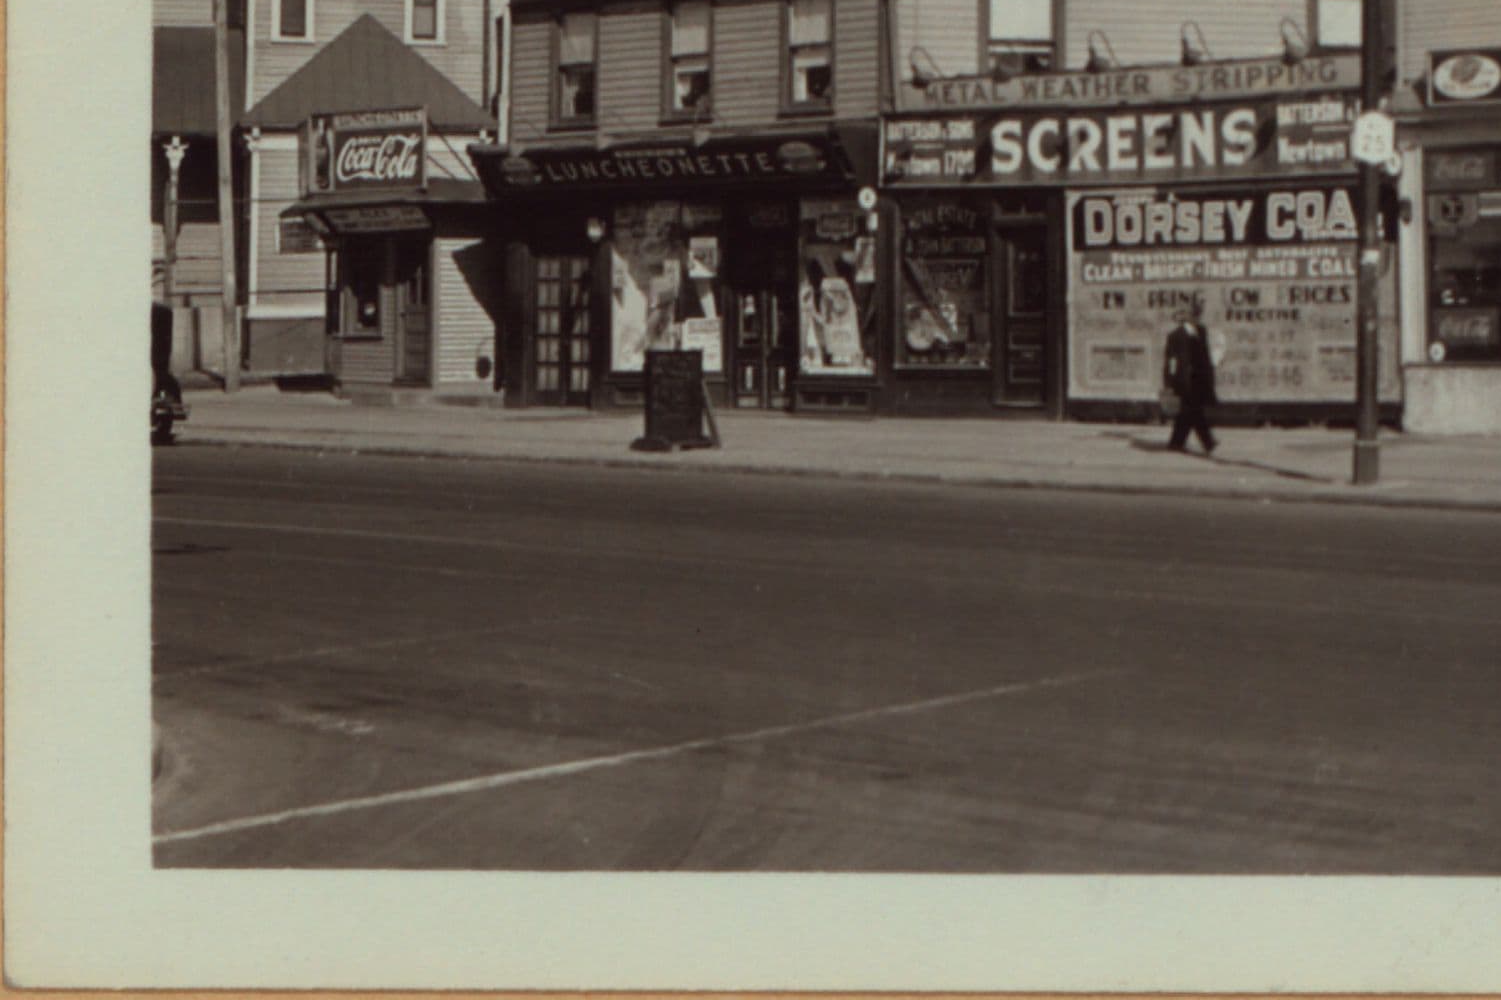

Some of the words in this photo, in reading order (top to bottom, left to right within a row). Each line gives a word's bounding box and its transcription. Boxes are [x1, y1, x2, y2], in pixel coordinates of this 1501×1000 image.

[924, 78, 1006, 105] METAL
[1022, 72, 1150, 100] WEATHER
[1172, 60, 1338, 93] STRIPPING
[336, 133, 422, 181] Coca-Cola
[991, 108, 1257, 173] SCREENS
[546, 152, 775, 181] LUNCHEONETTE
[1084, 199, 1253, 245] DORSEY
[1266, 189, 1384, 240] COA
[1084, 263, 1133, 281] CLEAN
[1250, 260, 1297, 276] MINED
[1307, 258, 1355, 276] COAL
[1137, 288, 1204, 309] PRING
